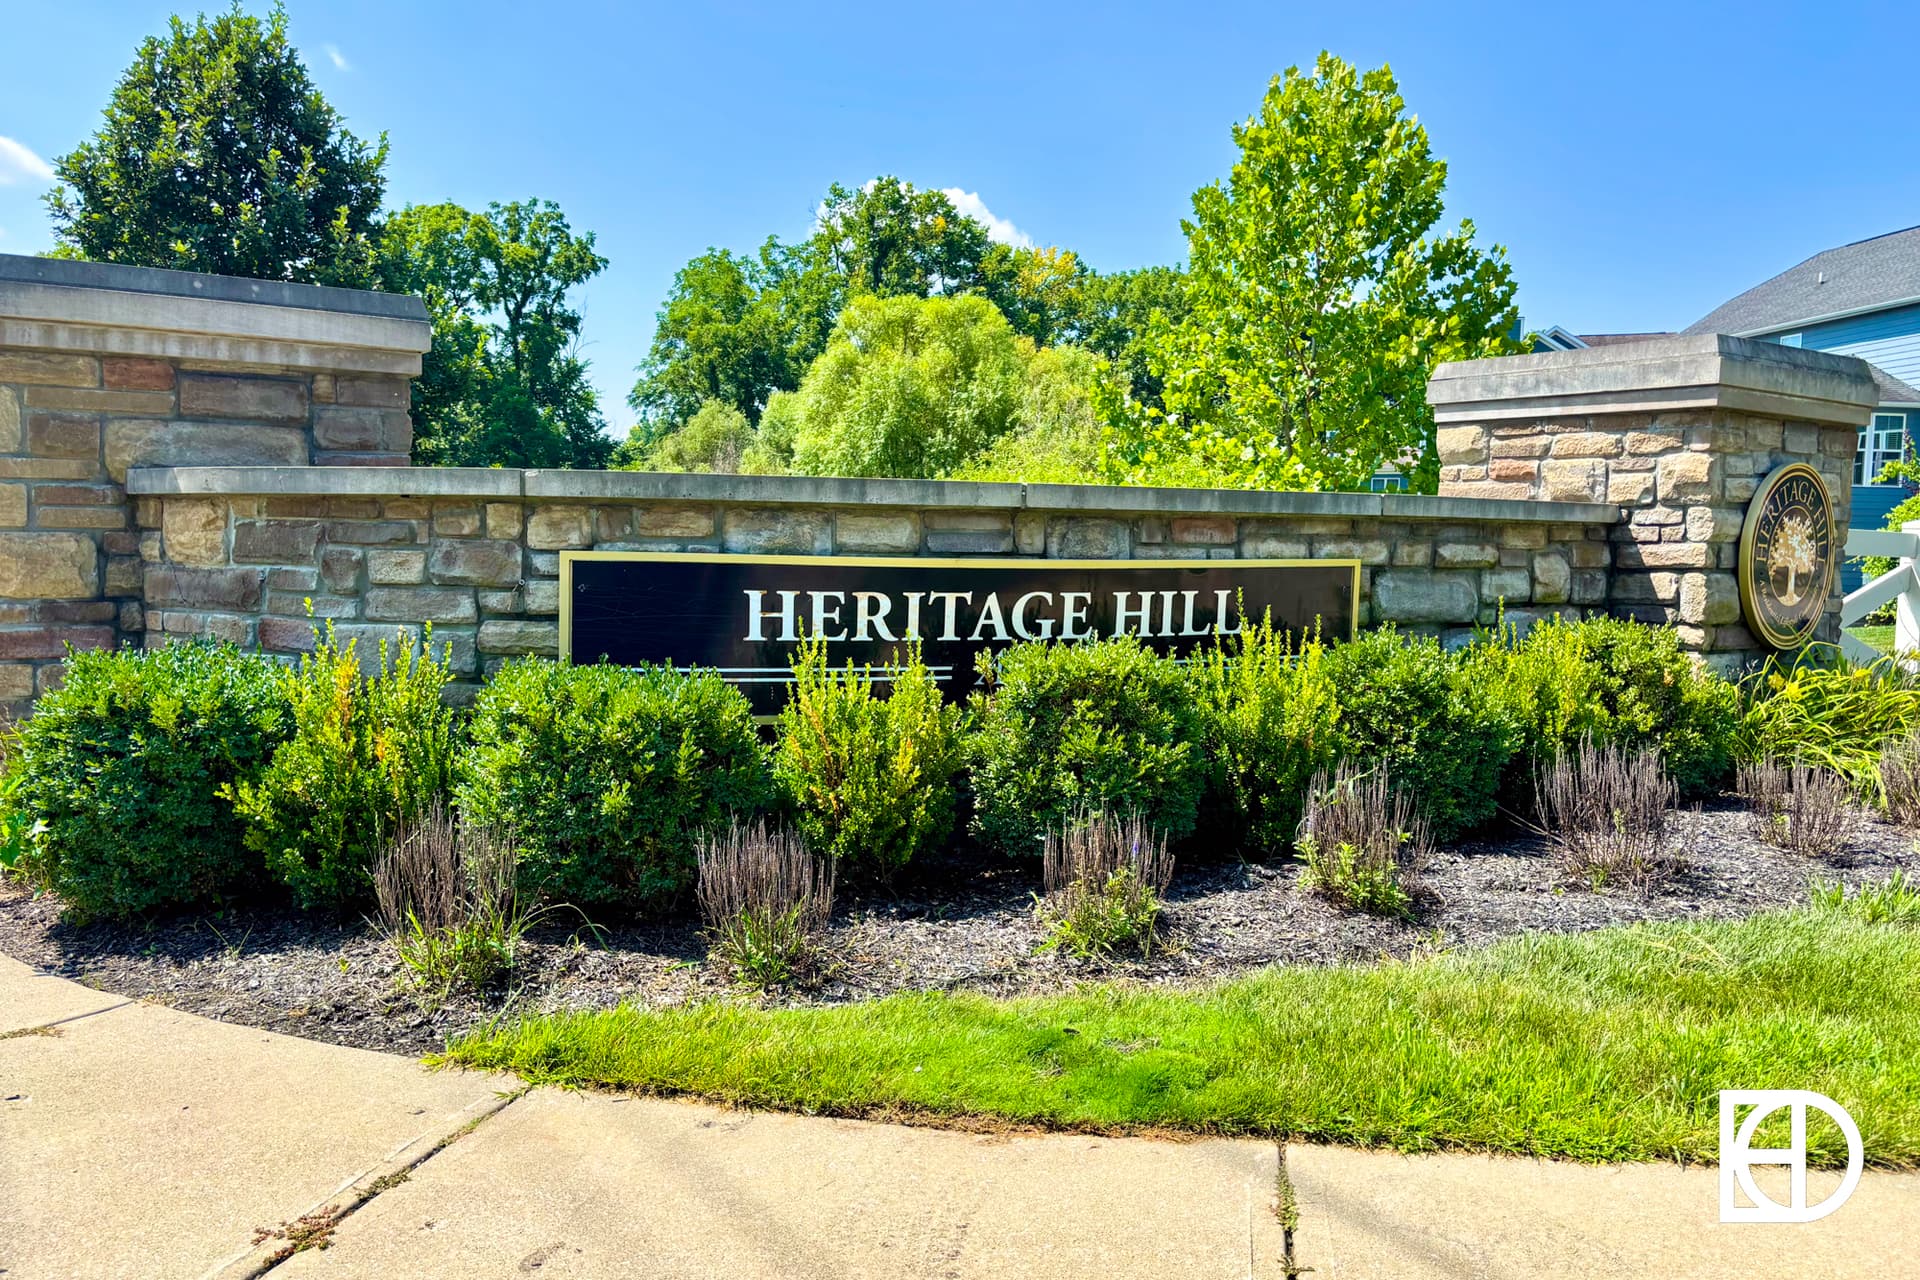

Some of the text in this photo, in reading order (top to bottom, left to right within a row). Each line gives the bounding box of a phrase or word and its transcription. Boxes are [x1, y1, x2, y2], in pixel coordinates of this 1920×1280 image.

[1756, 480, 1827, 569] HERITAGE HILL
[743, 589, 1242, 642] HERITAGE HILL
